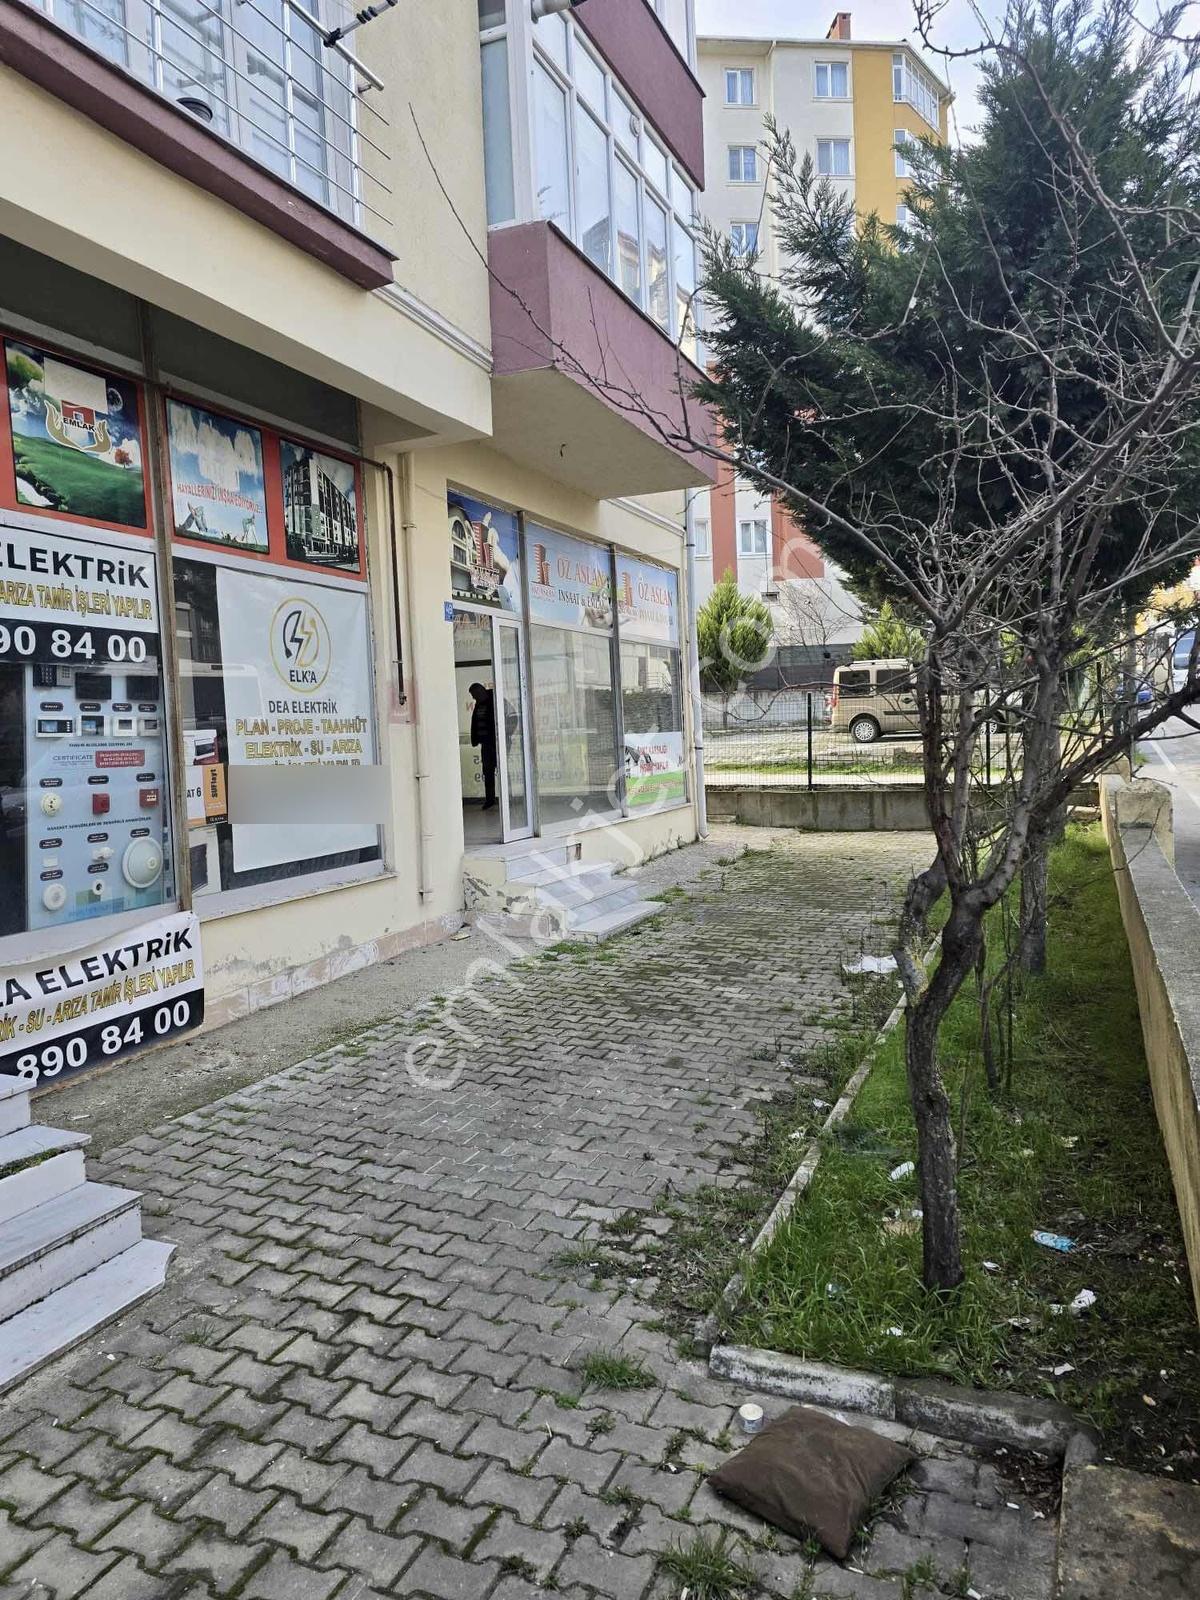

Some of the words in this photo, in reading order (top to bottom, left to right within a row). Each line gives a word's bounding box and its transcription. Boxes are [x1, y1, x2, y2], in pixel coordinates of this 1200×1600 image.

[63, 417, 96, 432] EMLAK
[37, 583, 73, 611] TAMİR
[75, 585, 111, 618] İŞLERİ
[111, 594, 153, 621] YAPILIR
[651, 586, 673, 608] ASLAN
[51, 629, 96, 659] 84
[107, 634, 147, 663] 00
[268, 700, 289, 714] DEA
[292, 698, 338, 714] ELEKTRİK
[236, 719, 269, 736] PLAN
[277, 719, 313, 735] PROJE
[245, 738, 302, 759] ELEKTRİK
[310, 740, 324, 756] SU
[332, 738, 363, 755] ARIZA
[0, 978, 32, 1008] A
[26, 1008, 46, 1033] SU
[52, 993, 88, 1025] ARIZA
[91, 979, 123, 1011] TAMİR
[124, 965, 158, 1004] İŞLERİ
[158, 959, 195, 990] YAPILIR
[16, 1037, 88, 1080] 890
[101, 1017, 143, 1055] 84
[154, 1000, 190, 1035] 00
